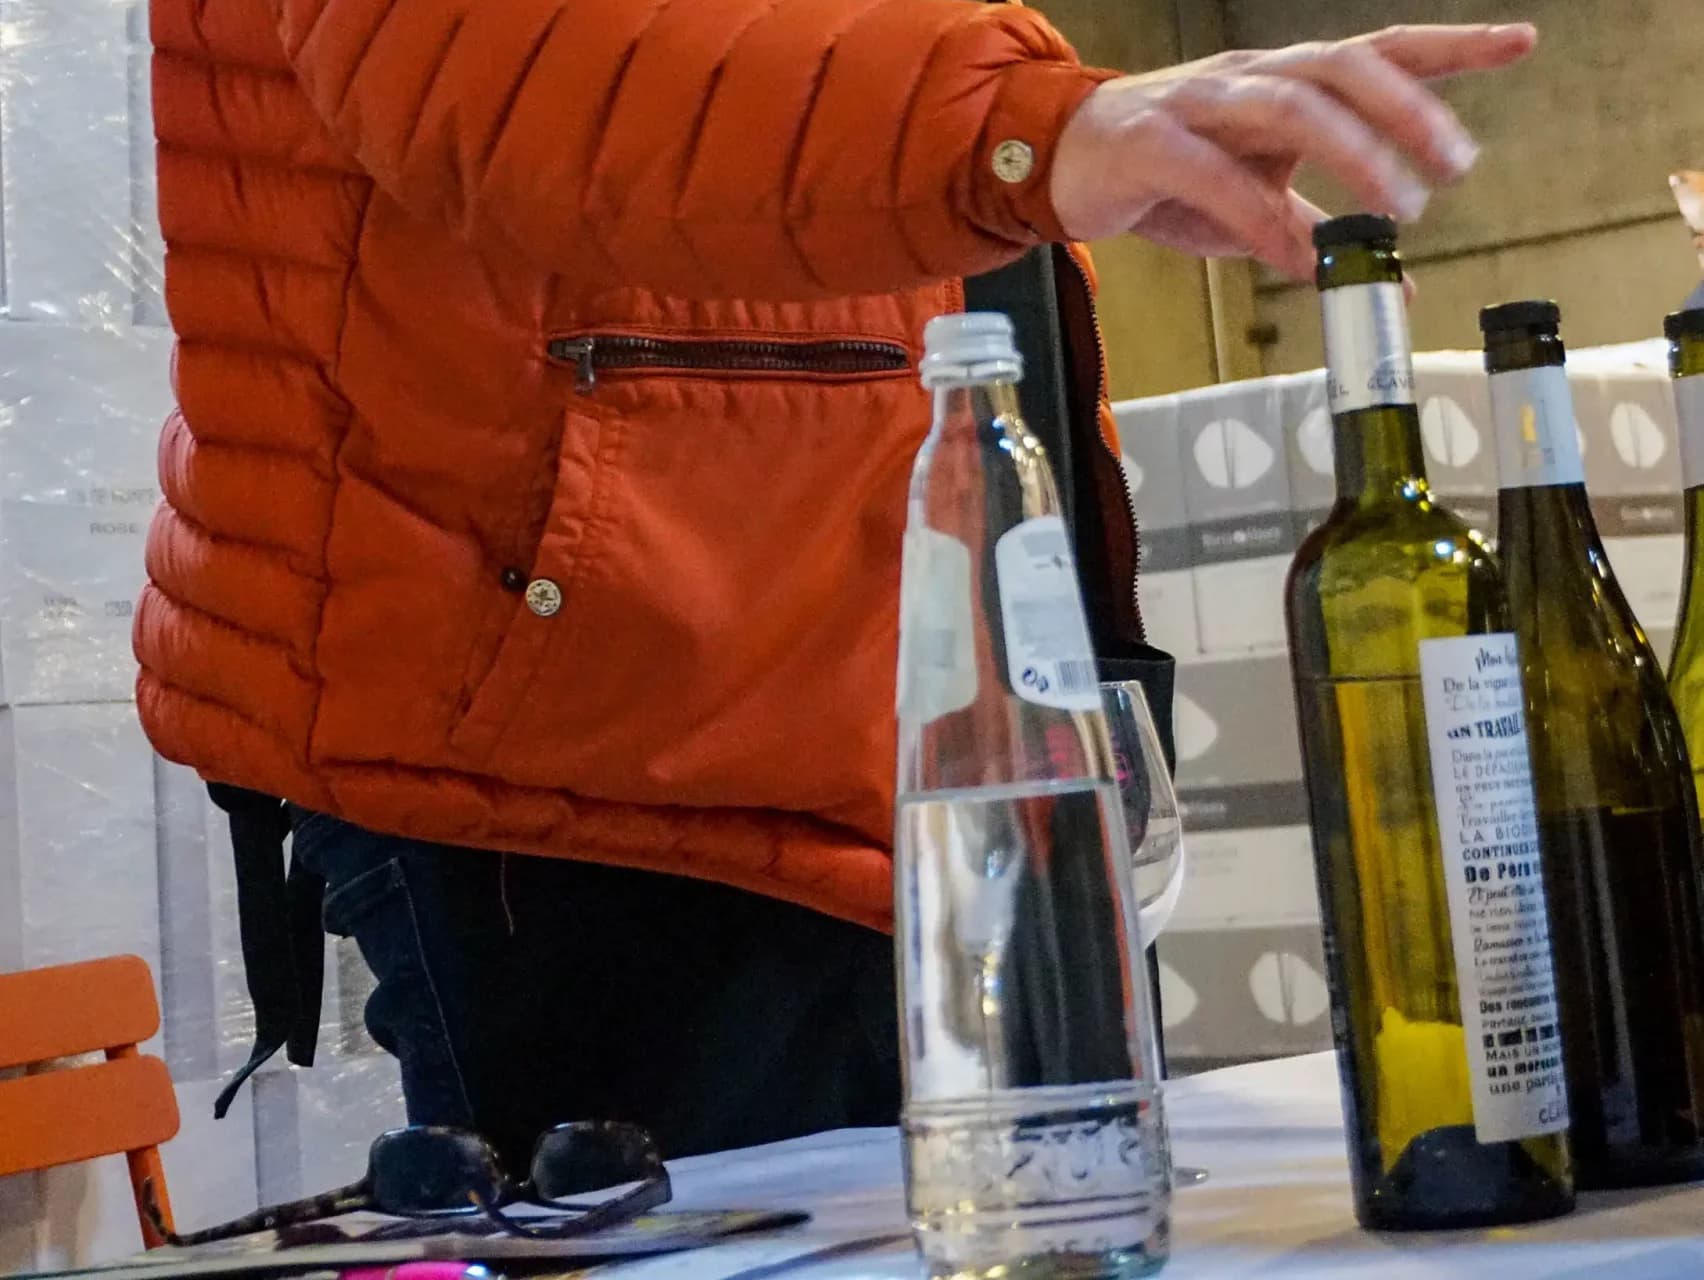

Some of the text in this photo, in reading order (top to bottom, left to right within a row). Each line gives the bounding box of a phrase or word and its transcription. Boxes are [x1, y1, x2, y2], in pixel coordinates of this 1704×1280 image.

[1468, 675, 1480, 690] la
[1460, 829, 1484, 844] LA
[1488, 1065, 1508, 1078] un
